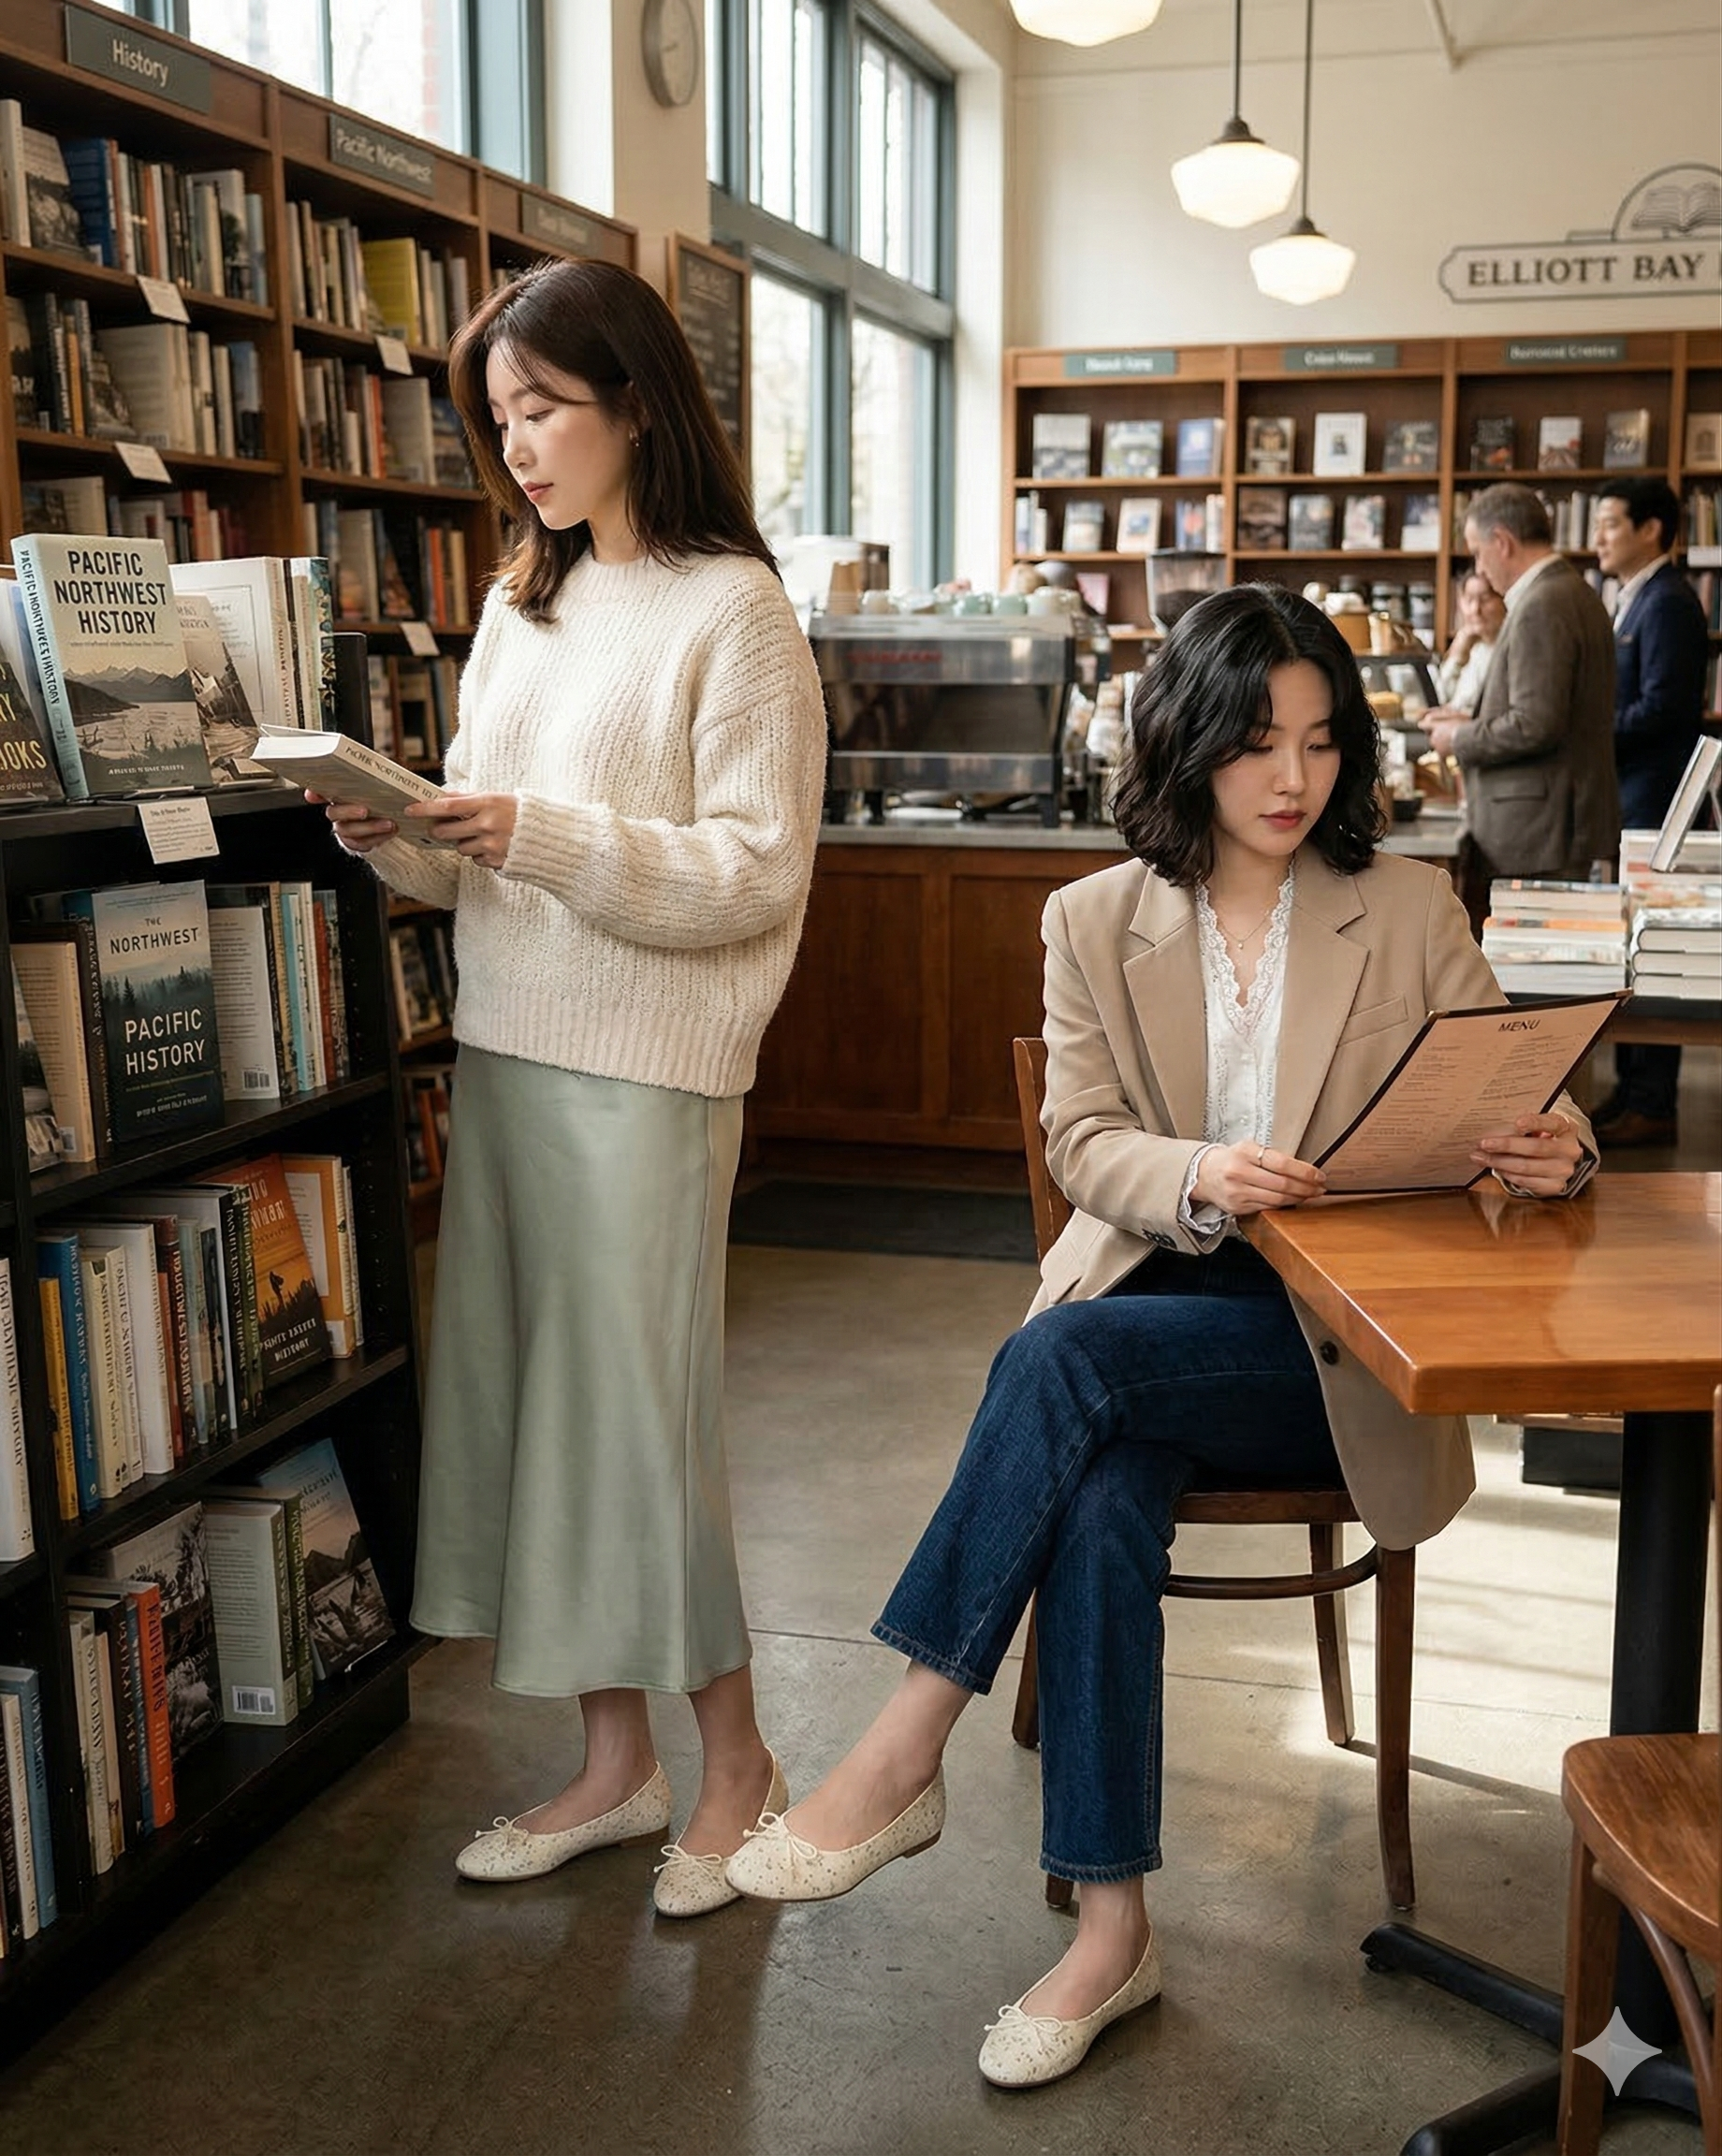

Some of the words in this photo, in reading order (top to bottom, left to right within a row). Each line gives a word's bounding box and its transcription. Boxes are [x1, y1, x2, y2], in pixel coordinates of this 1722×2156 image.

[112, 38, 168, 88] History
[1467, 257, 1618, 286] ELLIOTT
[1633, 253, 1705, 280] BAY
[67, 550, 143, 576] PACIFIC
[53, 580, 167, 605] NORTHWEST
[78, 610, 156, 634] HISTORY
[109, 927, 198, 954] NORTHWEST
[124, 1008, 202, 1043] PACIFIC
[1498, 1019, 1540, 1032] MENU
[125, 1039, 205, 1075] HISTORY
